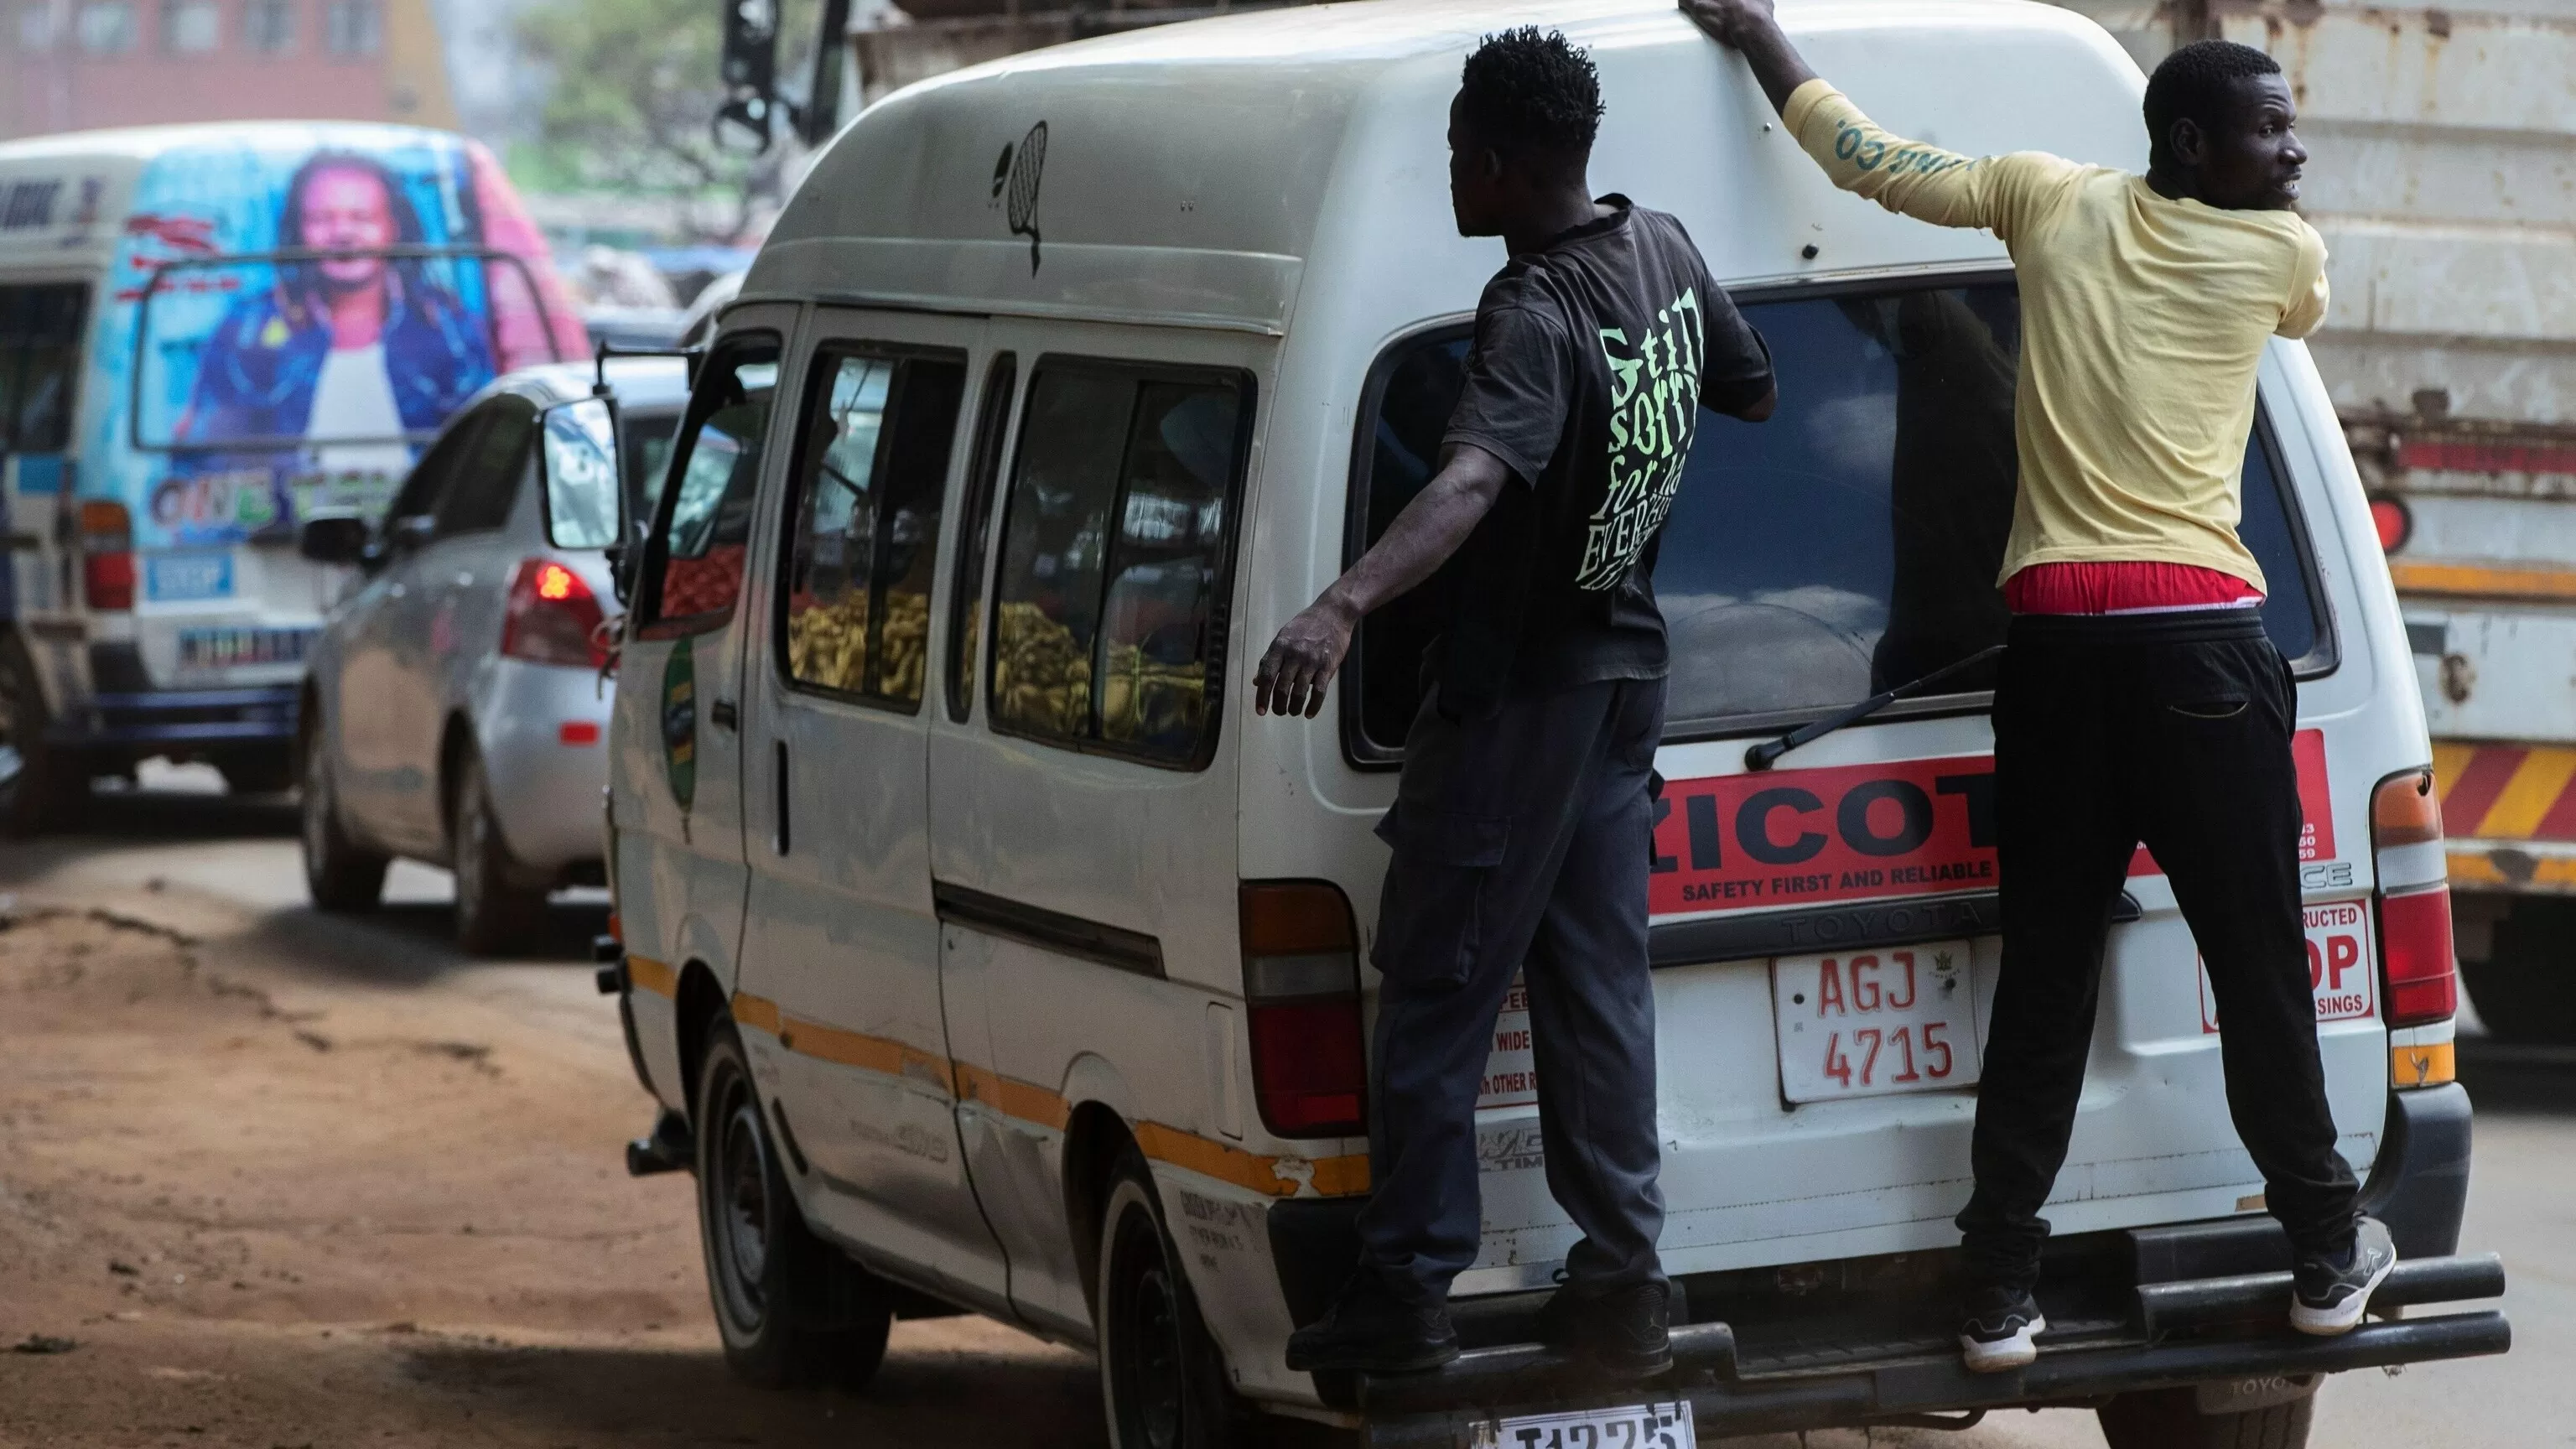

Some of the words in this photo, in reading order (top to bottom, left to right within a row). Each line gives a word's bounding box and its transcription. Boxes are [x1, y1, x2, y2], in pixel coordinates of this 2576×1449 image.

[1590, 454, 1658, 520] for
[1683, 880, 1763, 901] SAFETY
[1772, 873, 1832, 894] FIRST
[1840, 869, 1883, 889] AND
[1890, 860, 1992, 886] RELIABLE
[1779, 901, 1981, 943] TOYOTA
[1818, 951, 1916, 1019] AGJ
[1496, 1031, 1530, 1052] WIDE
[1824, 1022, 1953, 1088] 4715
[1493, 1073, 1527, 1094] OTHER
